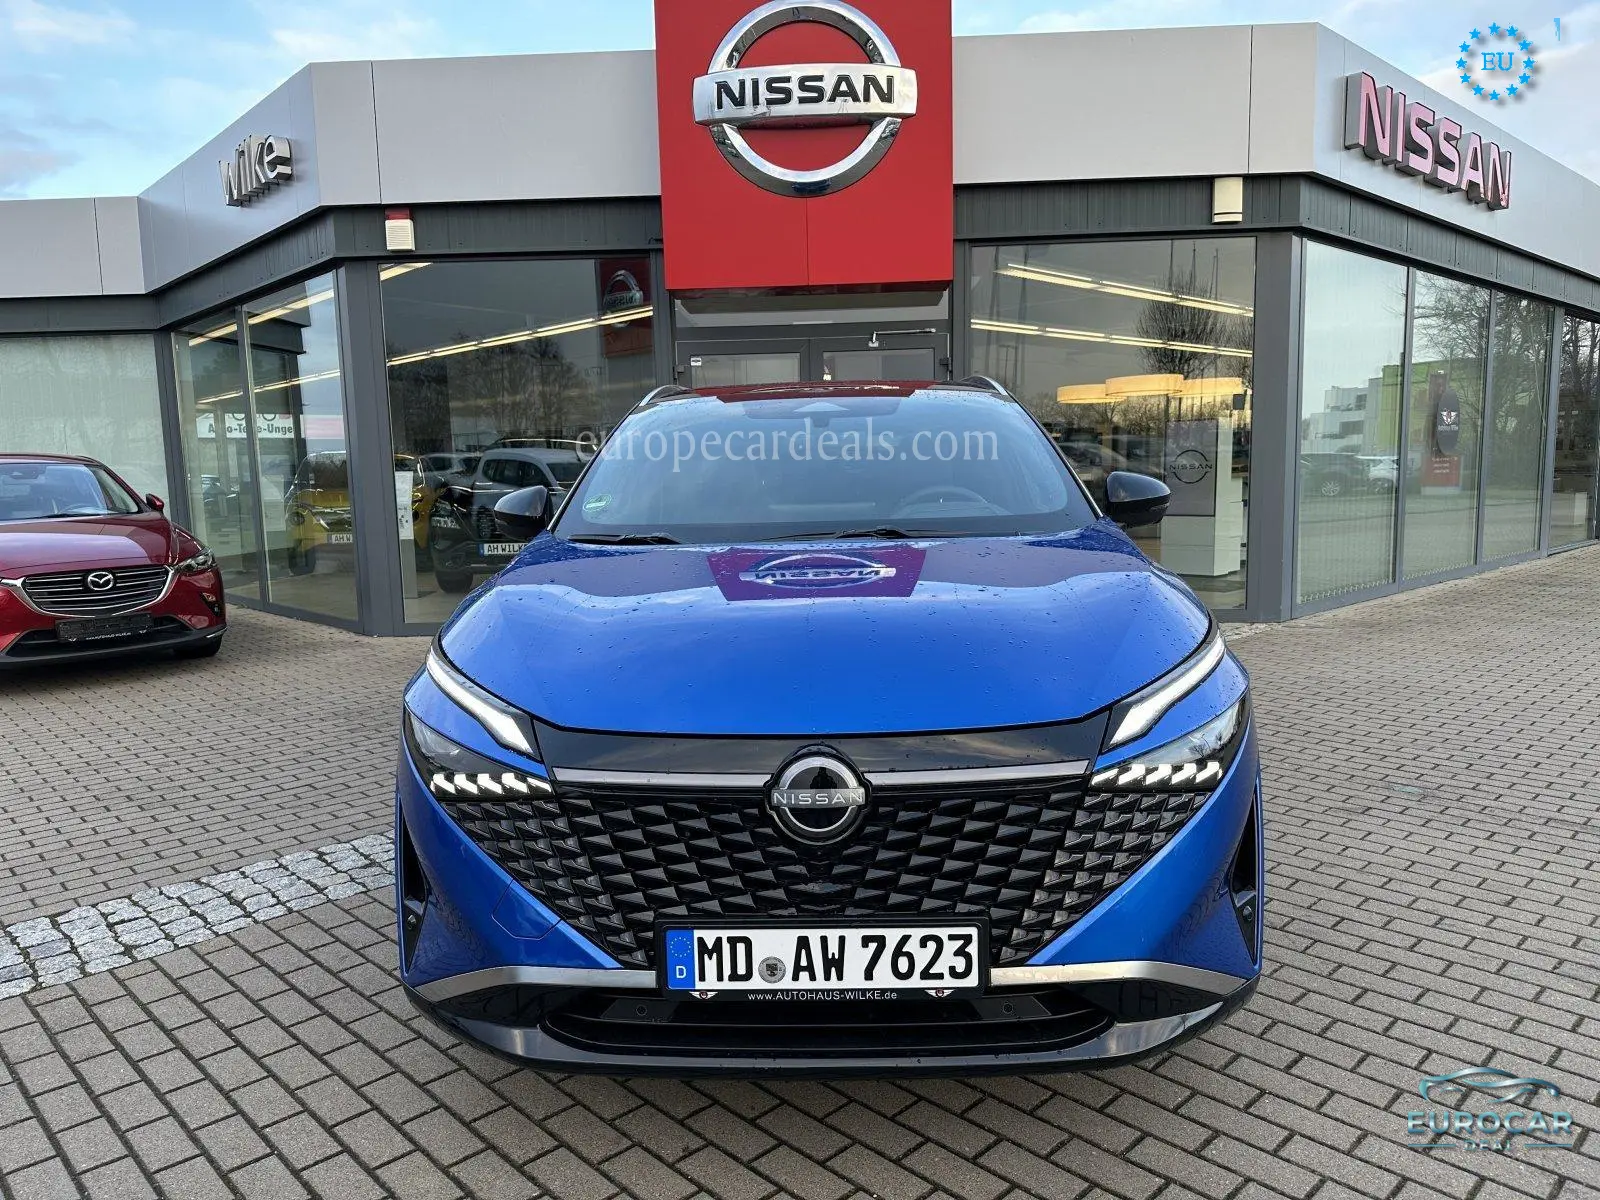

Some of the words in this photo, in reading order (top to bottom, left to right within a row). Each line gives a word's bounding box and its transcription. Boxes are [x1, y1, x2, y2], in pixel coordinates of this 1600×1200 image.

[715, 74, 895, 110] NISSAN
[1345, 71, 1512, 211] NISSAN
[487, 544, 499, 553] AH
[773, 793, 863, 805] NISSAN
[676, 966, 687, 979] D
[697, 936, 753, 982] MD
[791, 935, 846, 982] AW
[861, 933, 973, 981] 7623
[747, 991, 898, 1001] www.AUTOHAUS-WILKE.de
